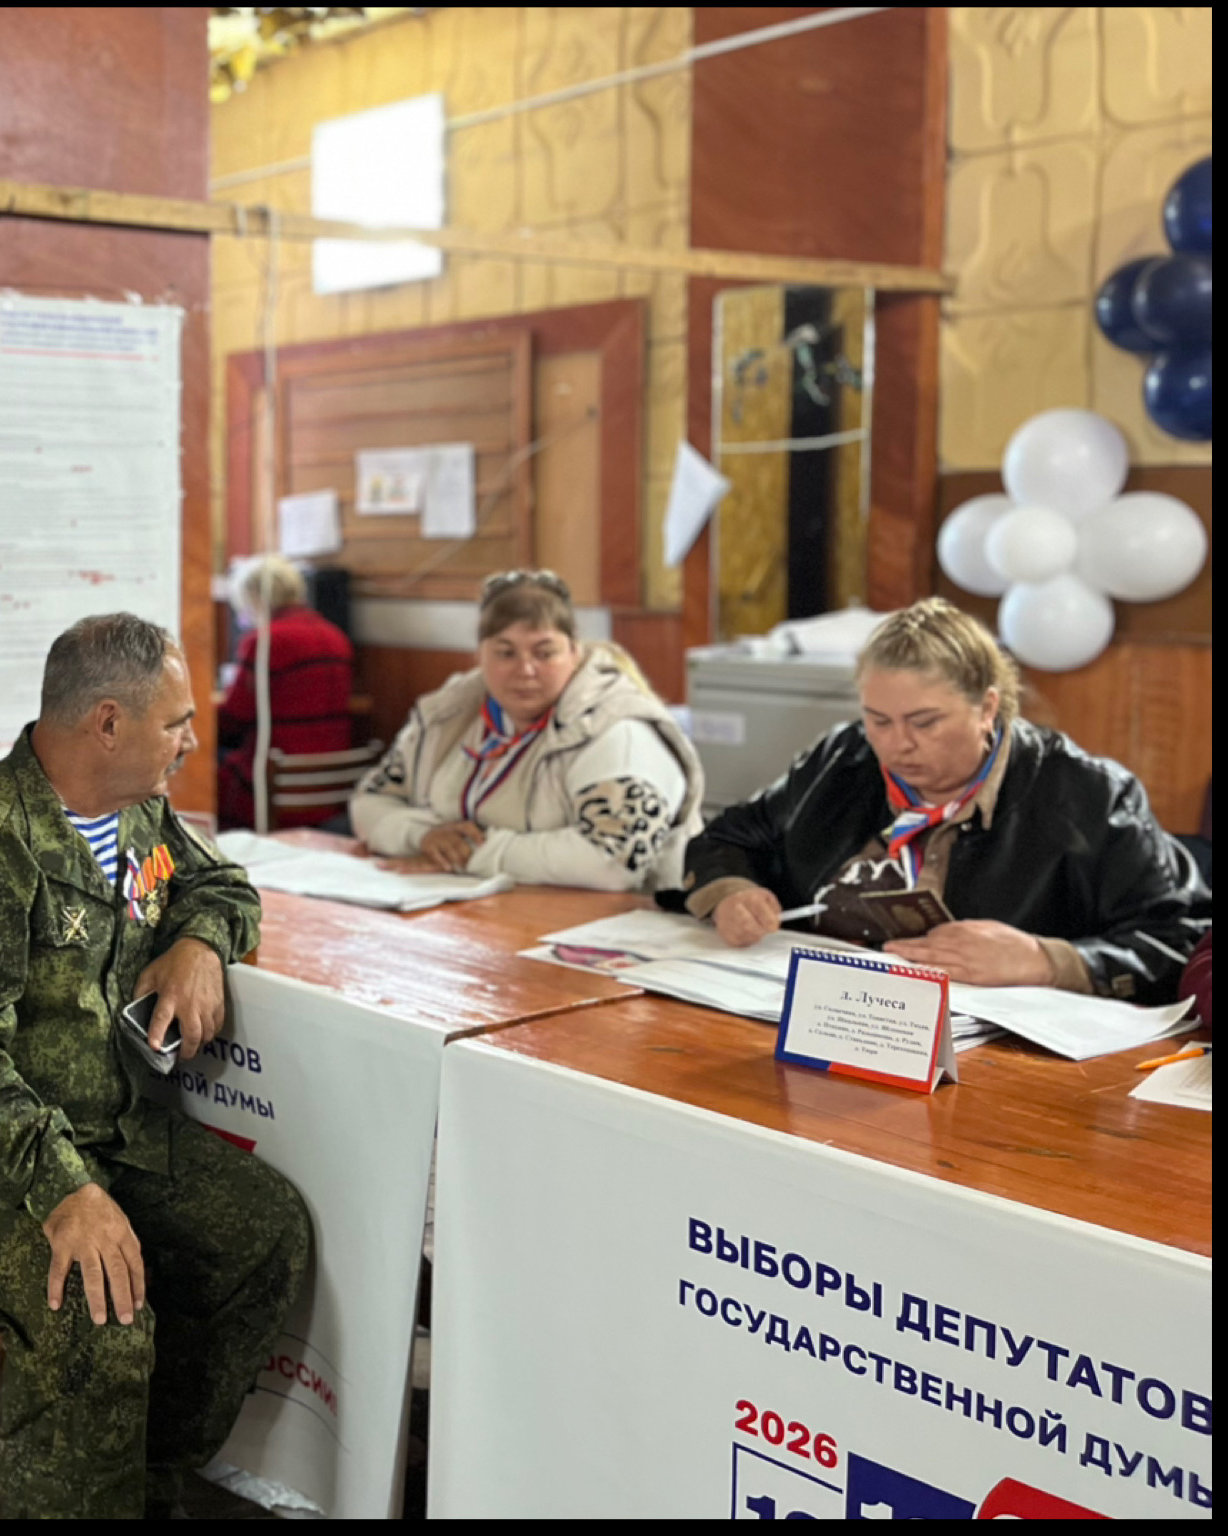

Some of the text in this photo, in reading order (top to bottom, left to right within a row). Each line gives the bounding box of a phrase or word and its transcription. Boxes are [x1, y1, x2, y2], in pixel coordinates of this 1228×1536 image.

[855, 991, 906, 1011] Лучеса
[214, 1082, 275, 1120] ДУМЫ
[688, 1216, 1212, 1436] ВЫБОРЫ ДЕПУТАТОВ
[678, 1278, 1068, 1454] ГОСУДАРСТВЕННОЙ
[734, 1399, 838, 1469] 2026
